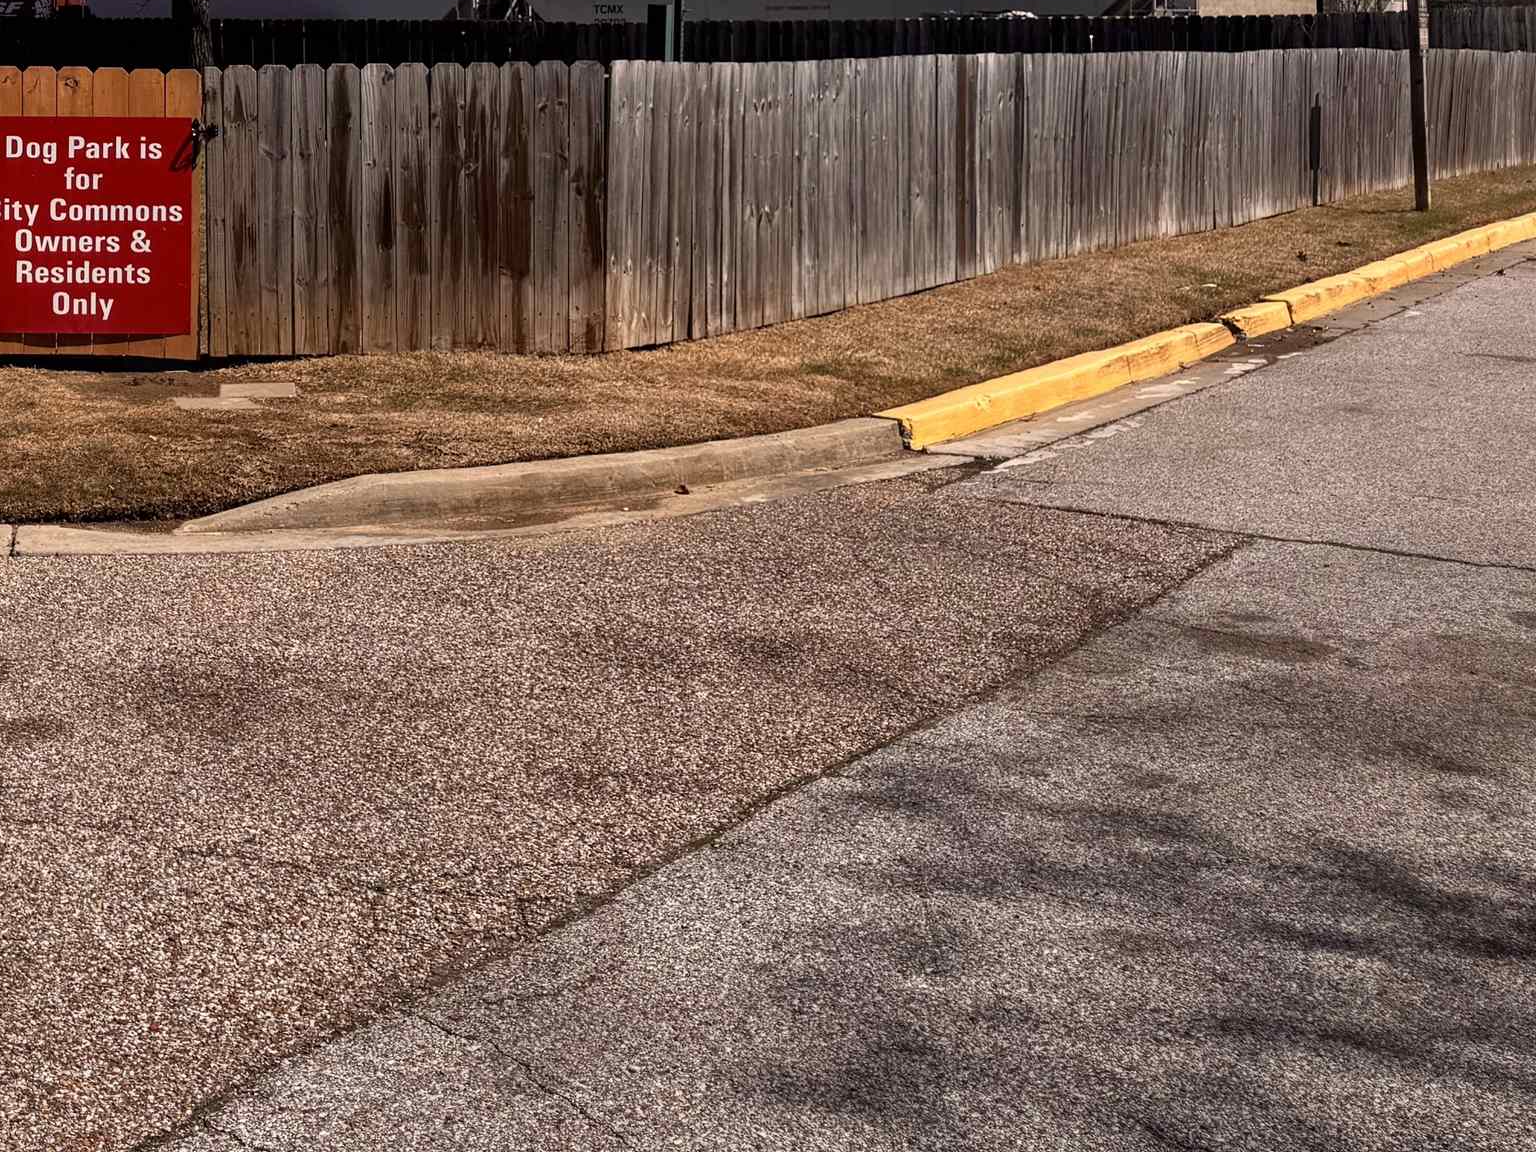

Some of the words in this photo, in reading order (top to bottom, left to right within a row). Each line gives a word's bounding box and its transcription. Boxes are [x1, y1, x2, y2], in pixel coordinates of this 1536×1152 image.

[593, 4, 624, 14] TCMX
[6, 135, 57, 164] Dog
[68, 135, 130, 160] Park
[139, 136, 162, 160] is
[64, 167, 104, 190] for
[50, 198, 184, 223] Commons
[15, 229, 121, 253] Owners
[131, 229, 152, 253] &
[16, 260, 151, 285] Residents
[52, 292, 114, 321] Only
